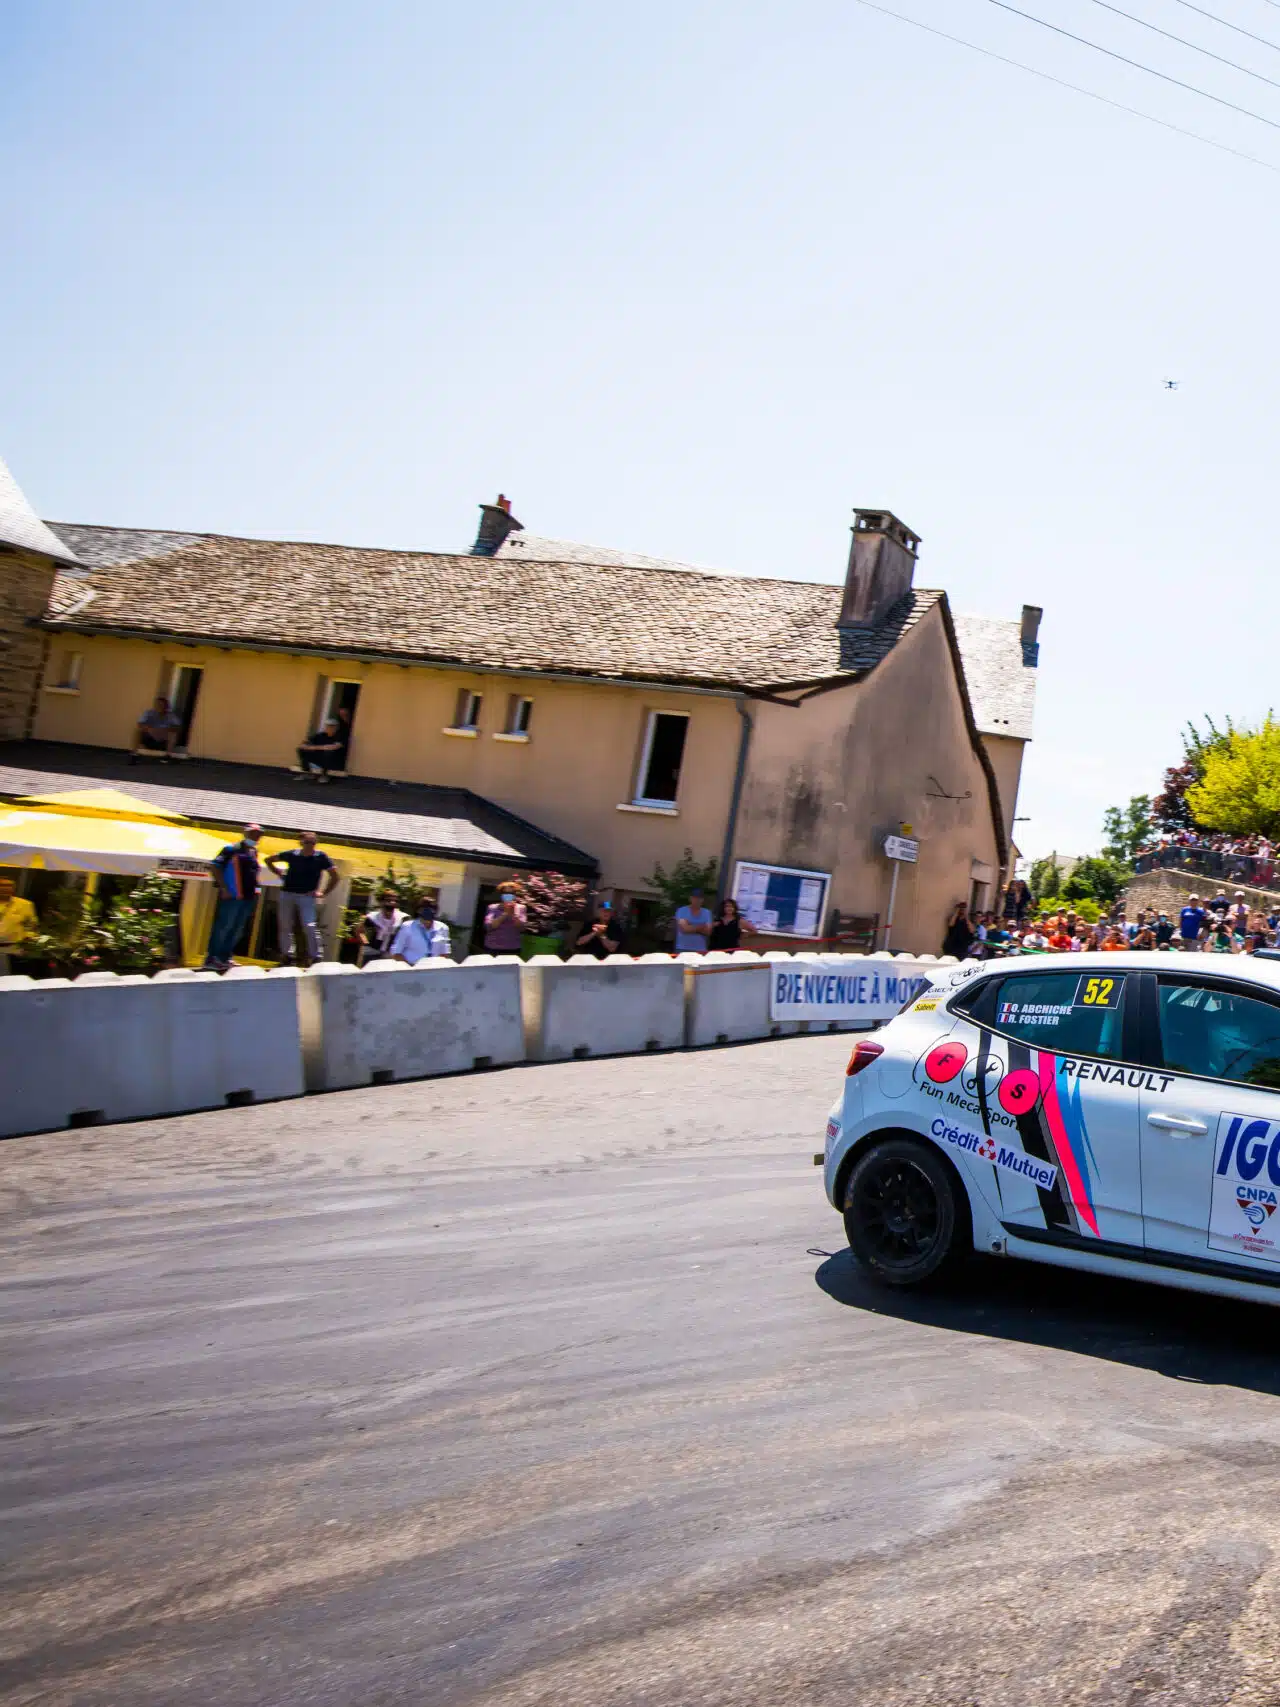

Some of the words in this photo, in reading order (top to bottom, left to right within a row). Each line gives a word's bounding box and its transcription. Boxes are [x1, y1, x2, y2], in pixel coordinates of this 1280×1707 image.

[776, 973, 868, 1004] BIENVENUE
[871, 971, 881, 1004] À
[1083, 978, 1114, 1005] 52
[1008, 1014, 1017, 1024] R.
[1019, 1014, 1060, 1026] FOSTIER
[1021, 1004, 1073, 1015] ABCHICHE
[937, 1053, 954, 1067] F
[1059, 1058, 1175, 1094] RENAULT
[919, 1081, 945, 1100] Fun
[948, 1091, 982, 1115] Meca
[1010, 1083, 1026, 1100] S
[931, 1118, 981, 1153] Crédit
[998, 1147, 1056, 1187] Mutuel
[1236, 1186, 1278, 1205] CNPA
